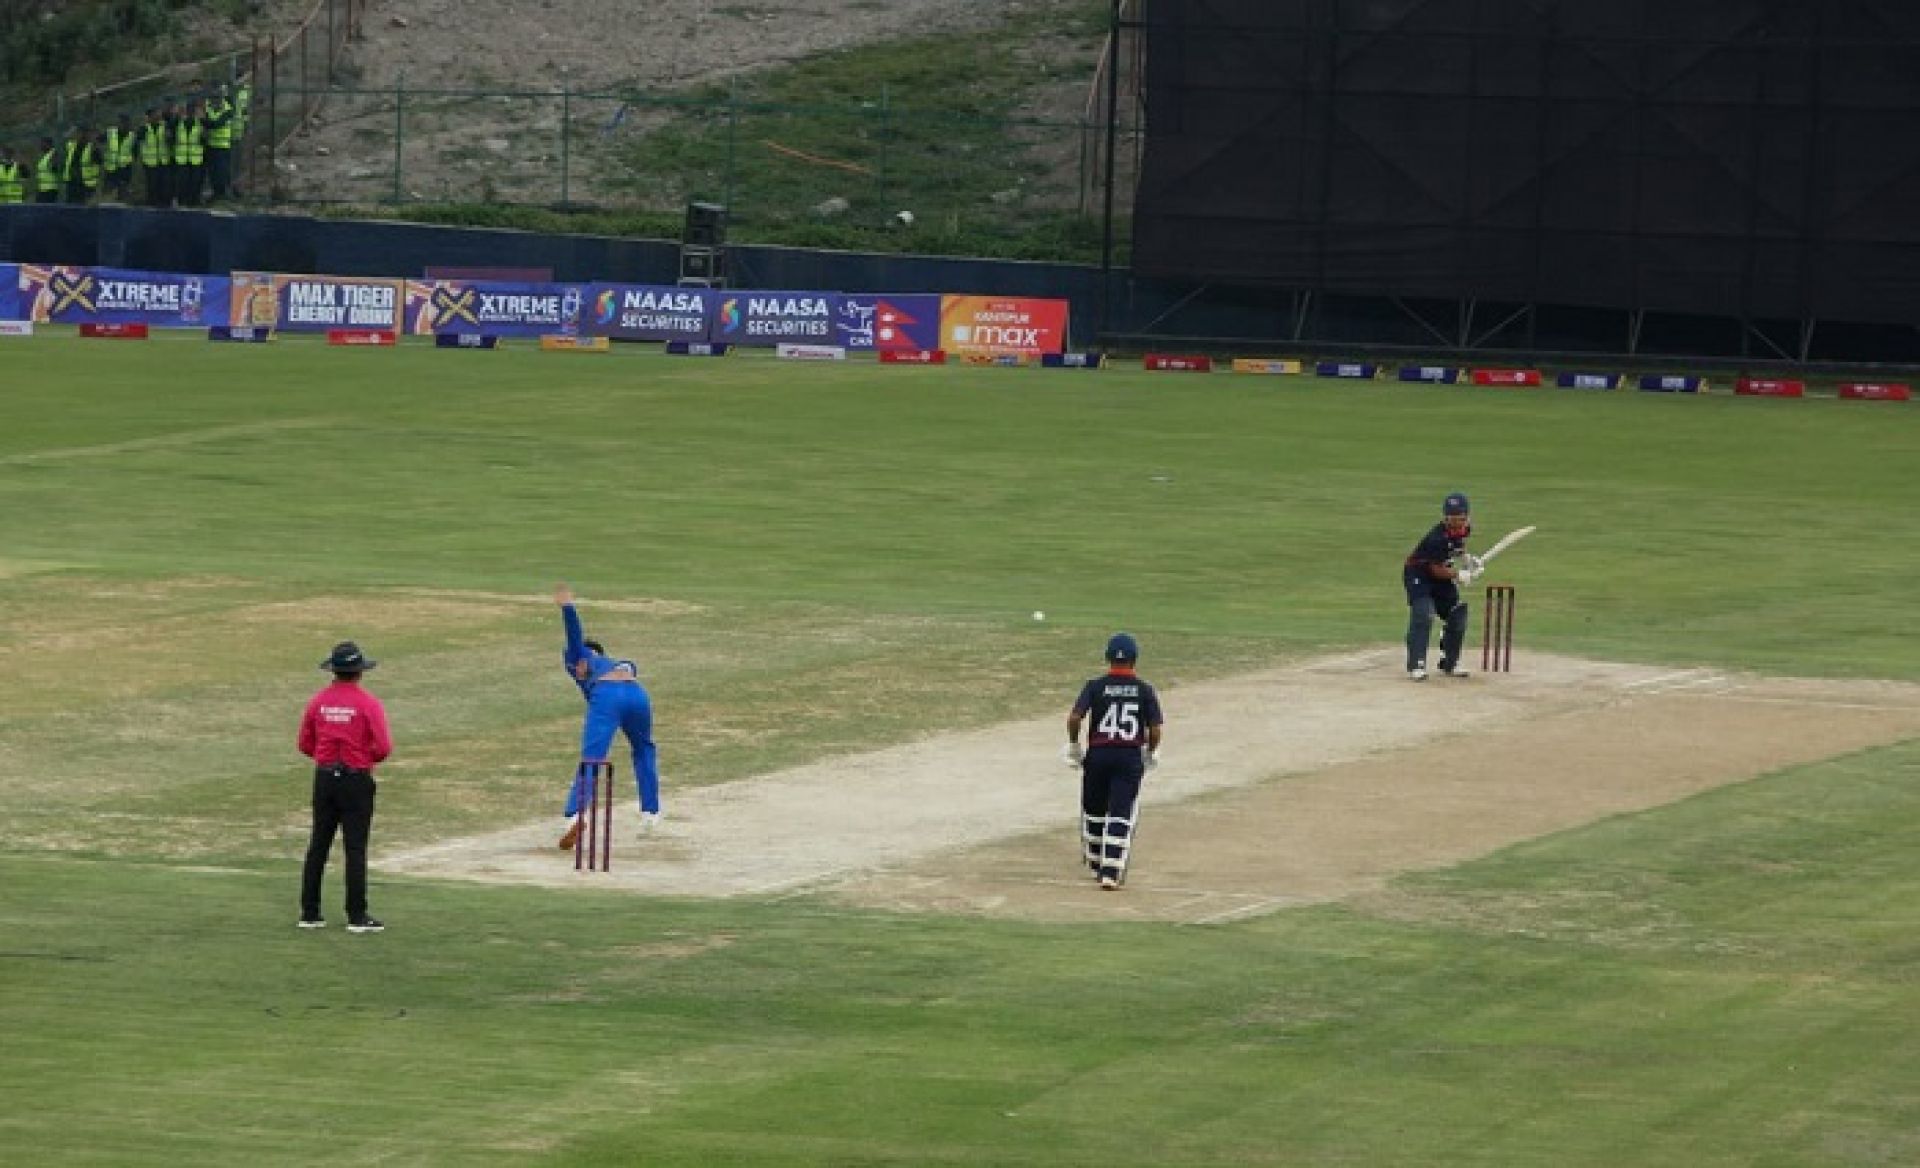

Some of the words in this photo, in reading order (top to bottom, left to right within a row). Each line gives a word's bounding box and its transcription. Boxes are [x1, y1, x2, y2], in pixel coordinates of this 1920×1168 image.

[98, 280, 179, 302] XTREME
[290, 281, 335, 305] MAX
[342, 284, 393, 307] TIGER
[623, 290, 703, 313] NAASA
[480, 292, 560, 313] XTREME
[747, 298, 829, 316] NAASA
[622, 313, 703, 332] SECURITIES
[745, 320, 829, 335] SECURITIES
[1097, 702, 1139, 740] 45
